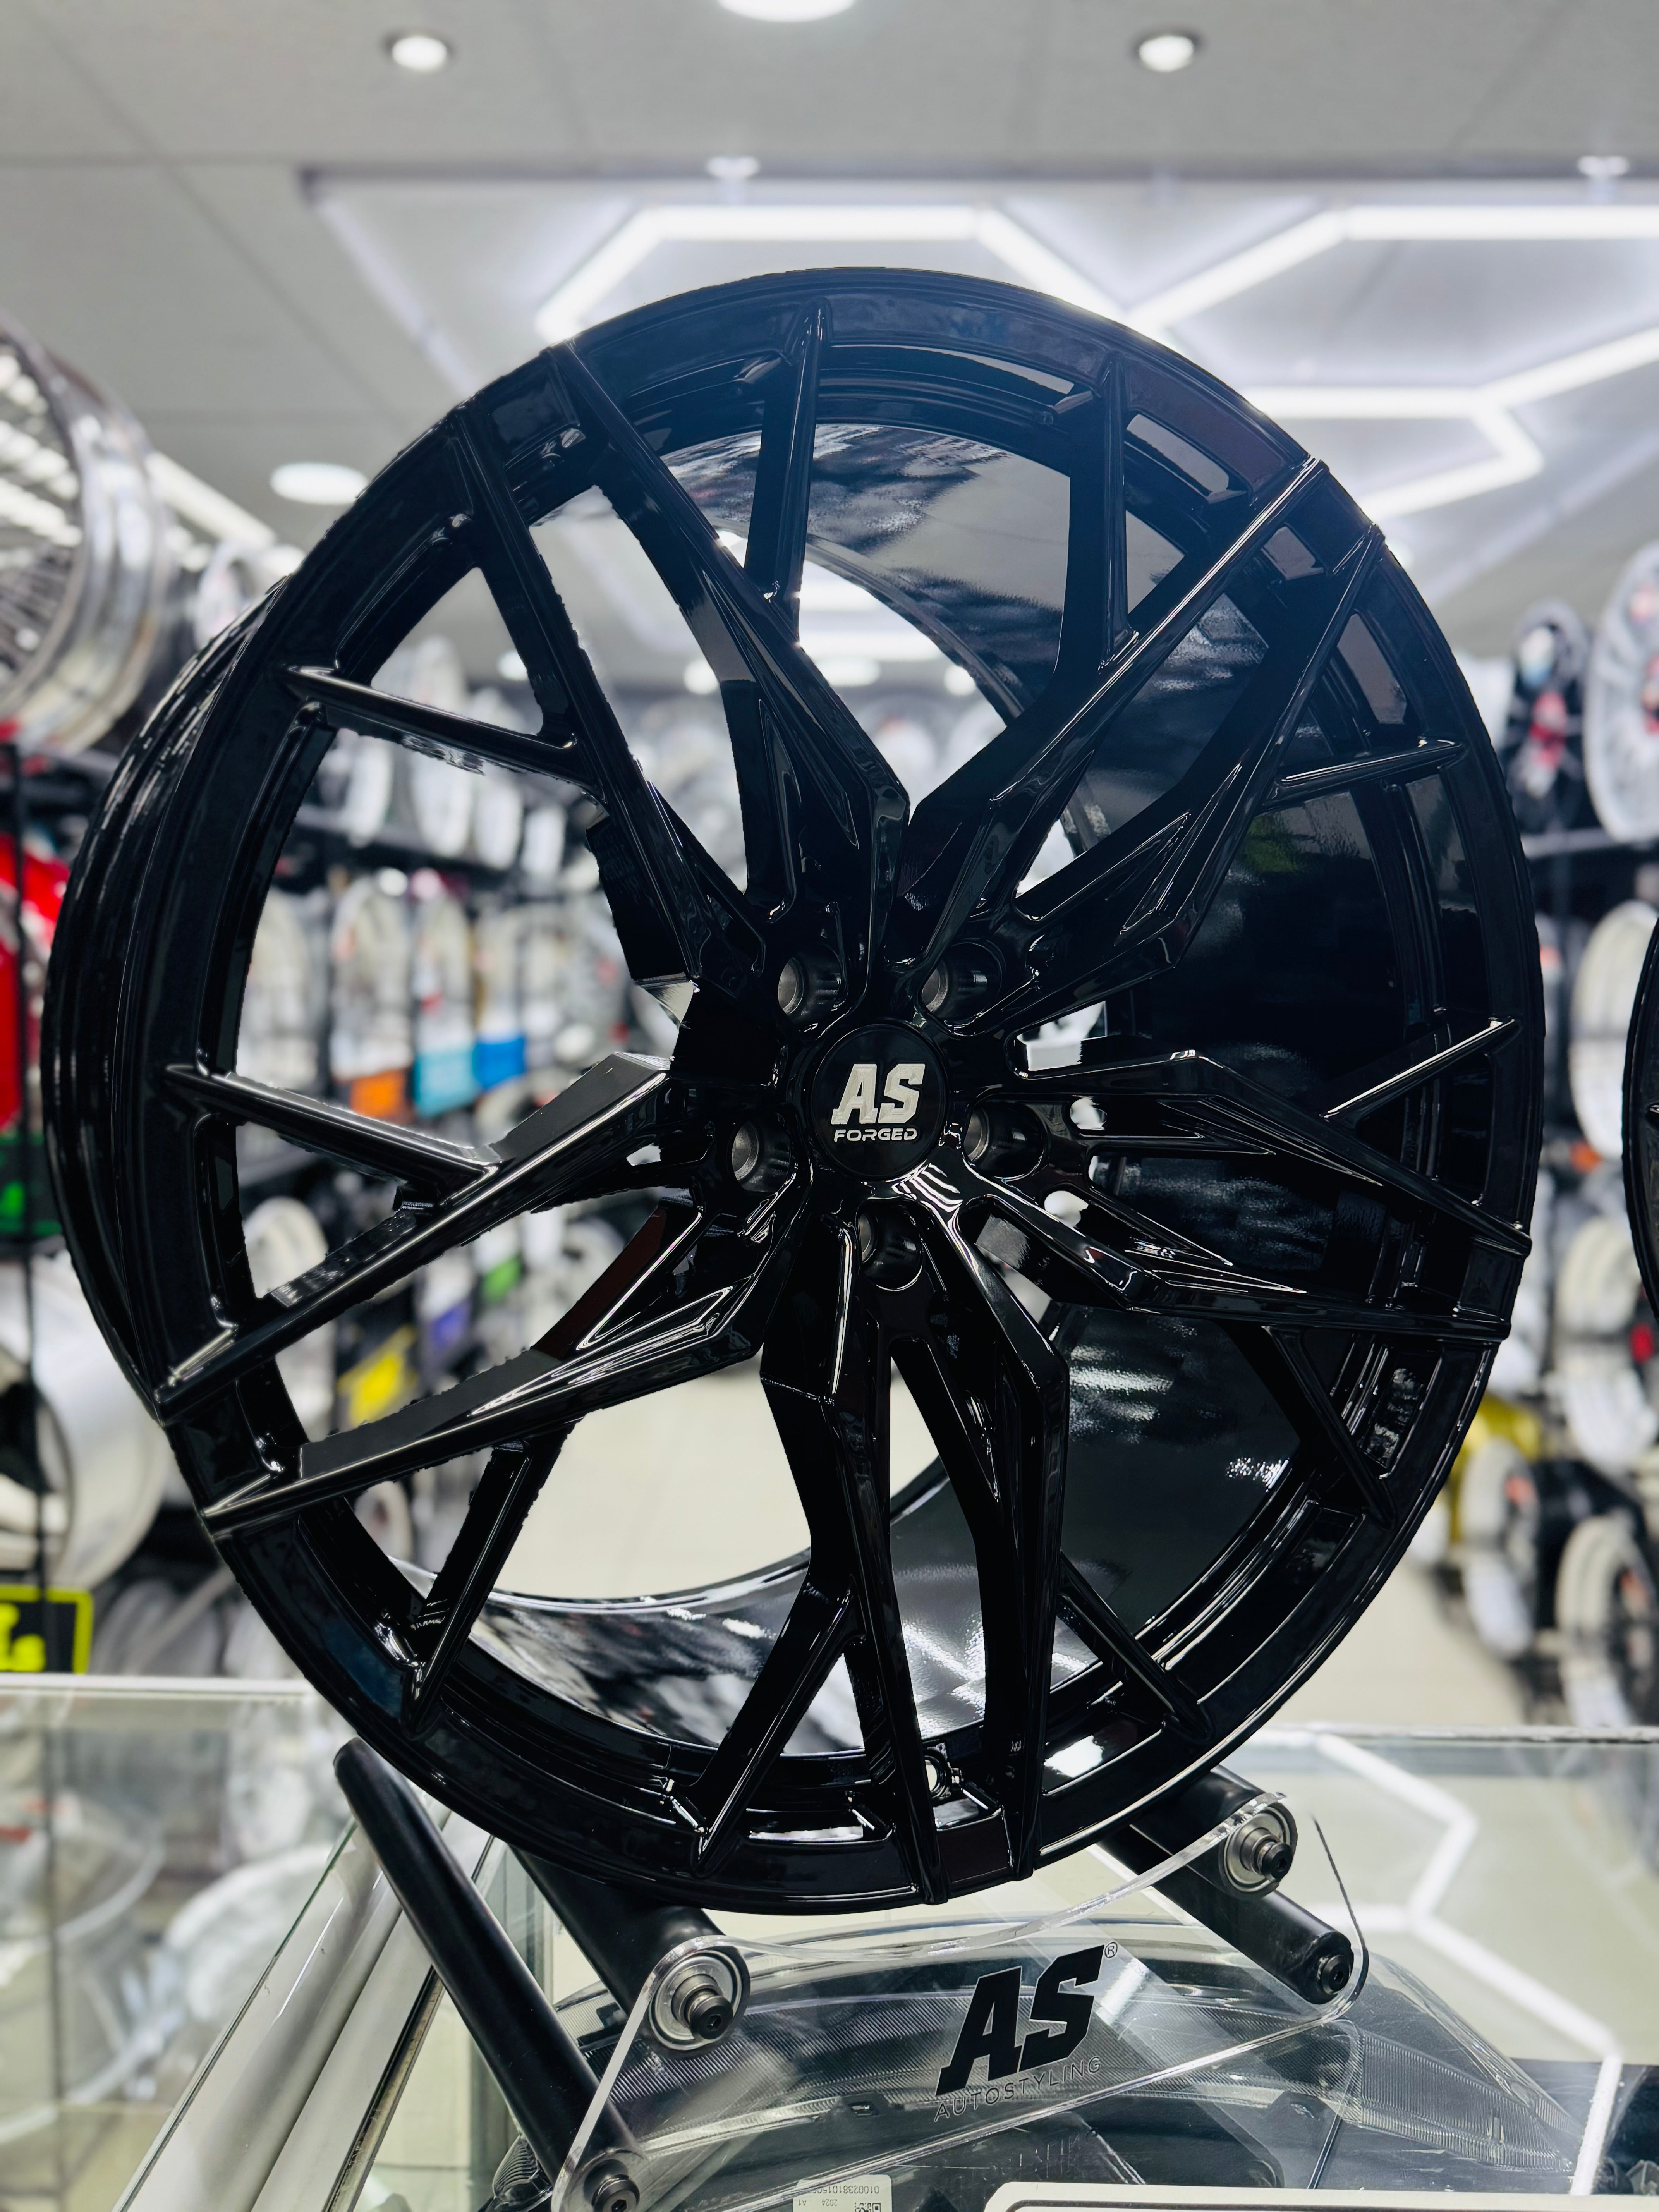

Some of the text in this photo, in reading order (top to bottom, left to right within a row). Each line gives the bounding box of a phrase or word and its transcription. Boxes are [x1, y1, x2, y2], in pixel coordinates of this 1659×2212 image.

[831, 1064, 925, 1125] AS
[834, 1128, 917, 1142] FORGED
[934, 2056, 1101, 2122] AUTOSTYLING
